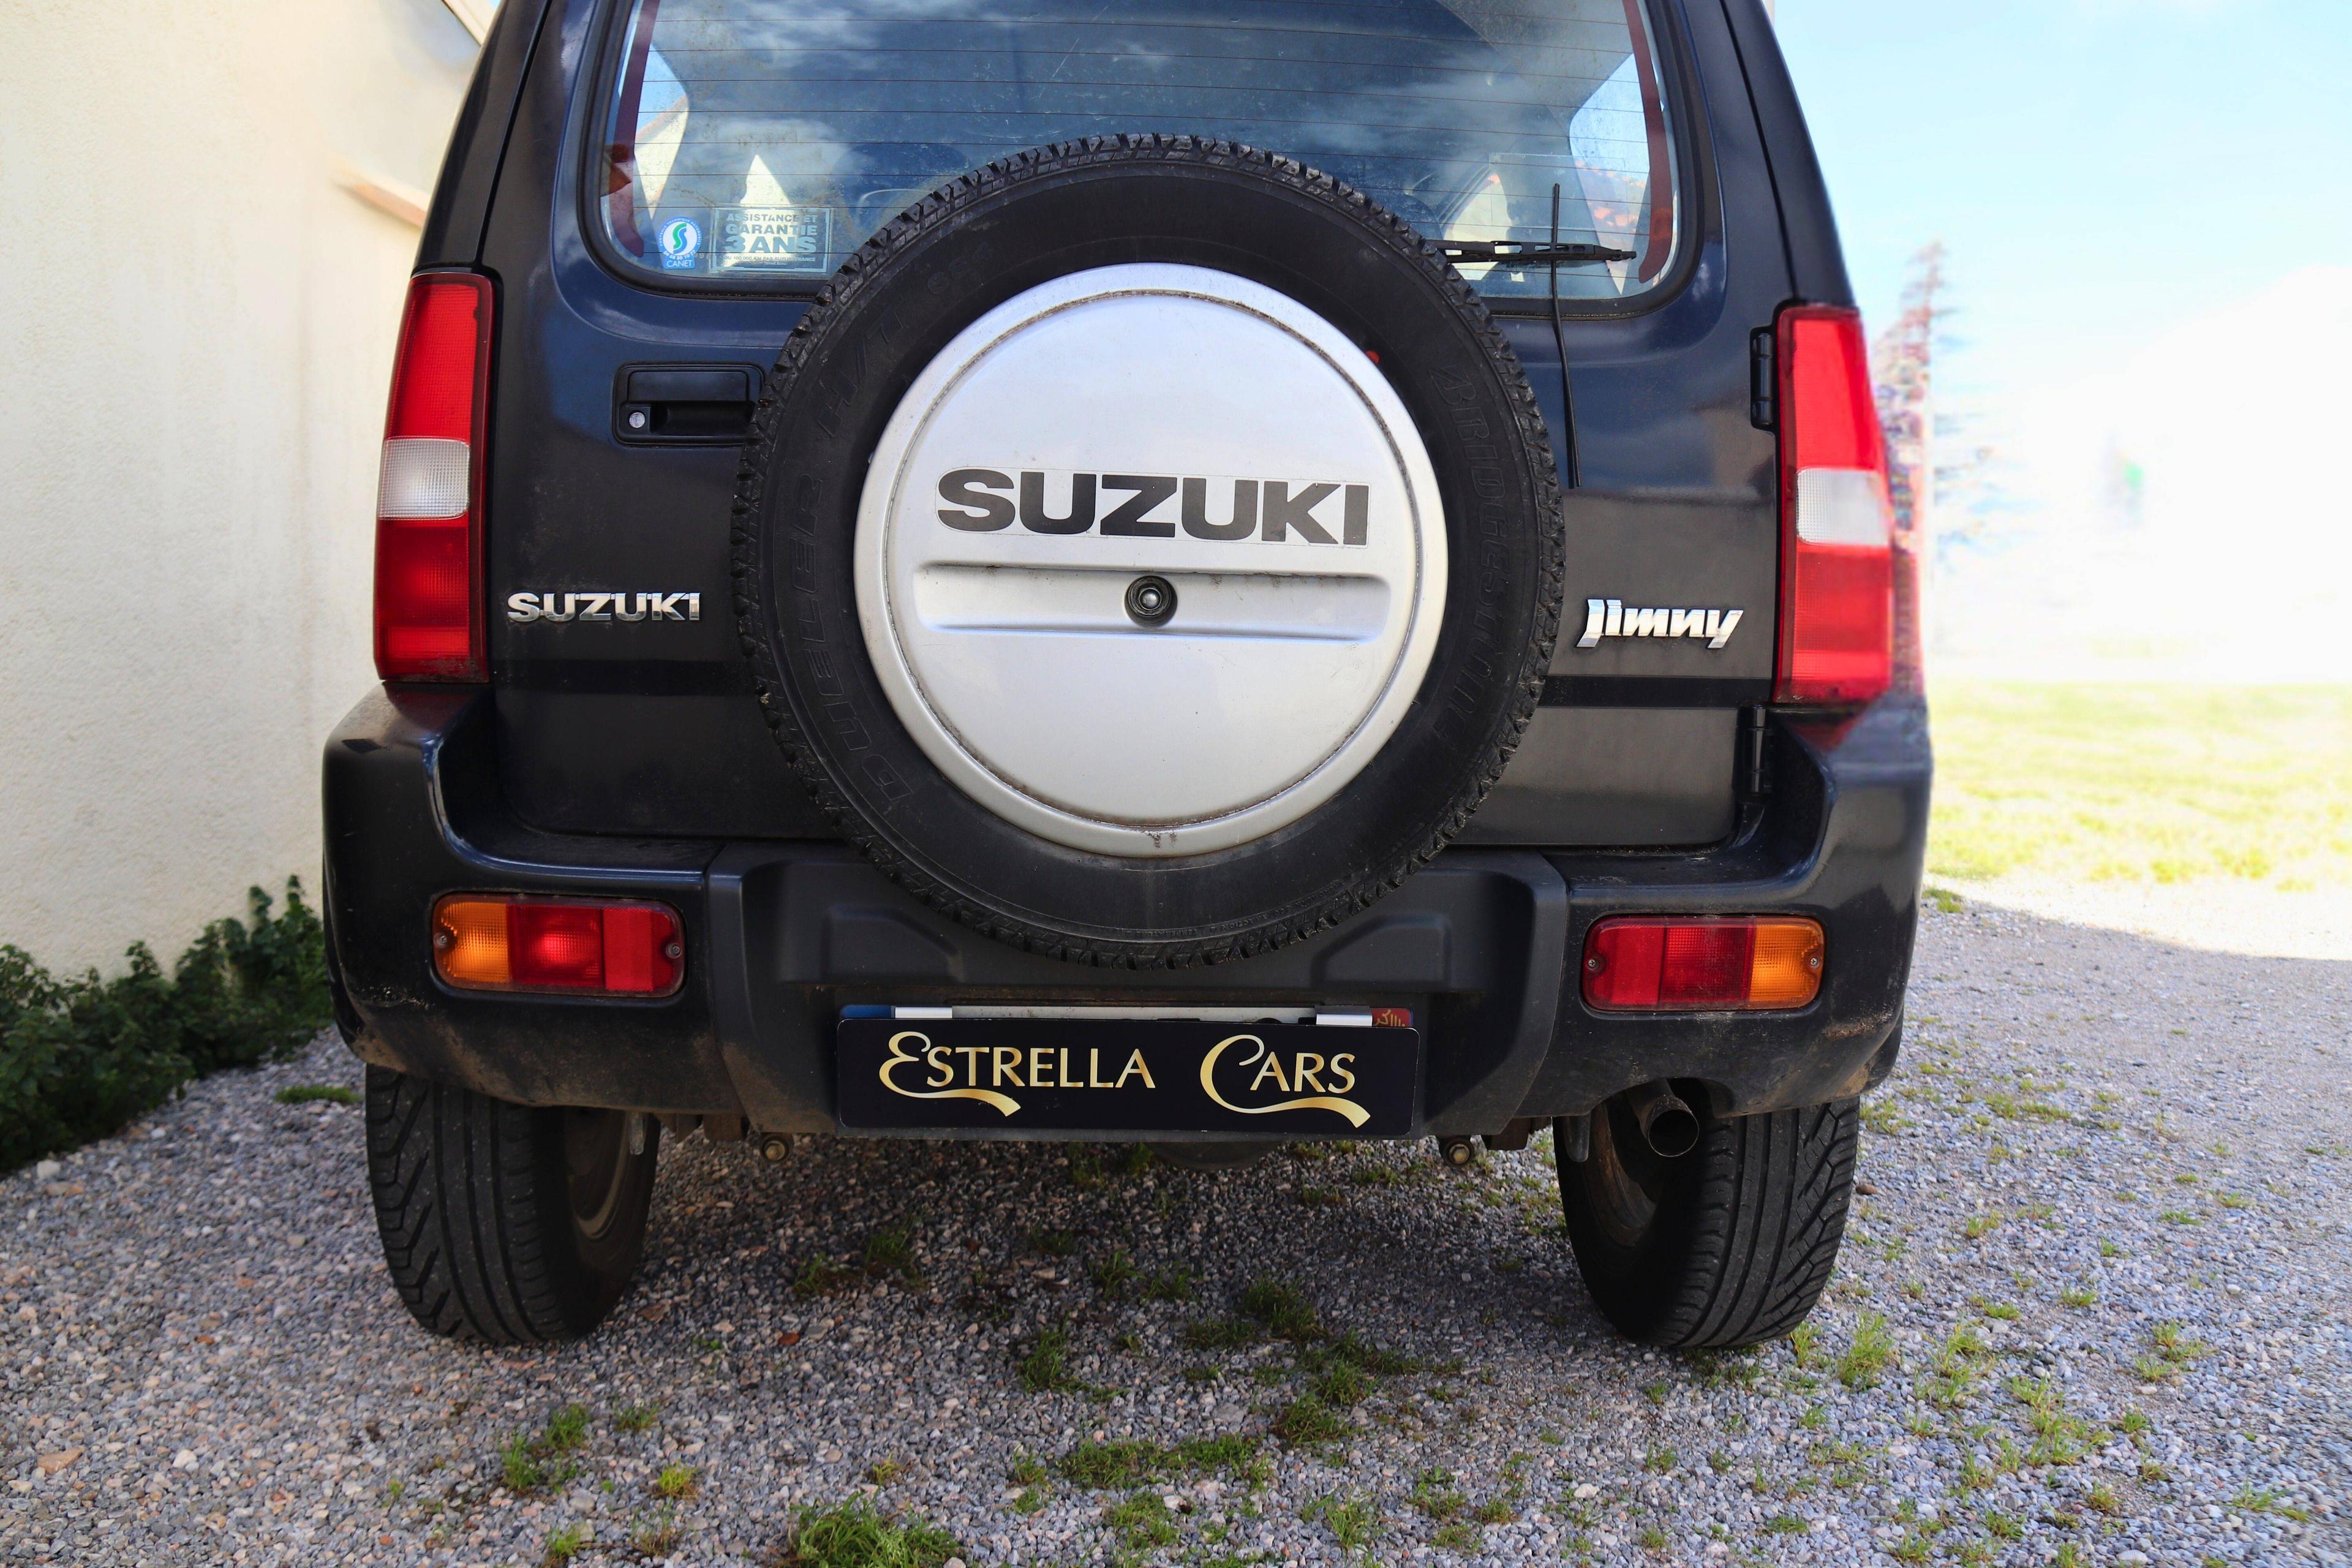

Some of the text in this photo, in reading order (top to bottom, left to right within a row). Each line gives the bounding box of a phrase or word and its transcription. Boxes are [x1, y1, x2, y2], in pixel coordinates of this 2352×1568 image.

[725, 224, 818, 235] GARANTIE
[726, 214, 818, 223] ASSISTANCE ET
[725, 235, 817, 254] 3 ANS
[937, 468, 1370, 546] SUZUKI
[507, 592, 701, 622] SUZUKI
[878, 1030, 1371, 1128] ESTRELLA CARS
